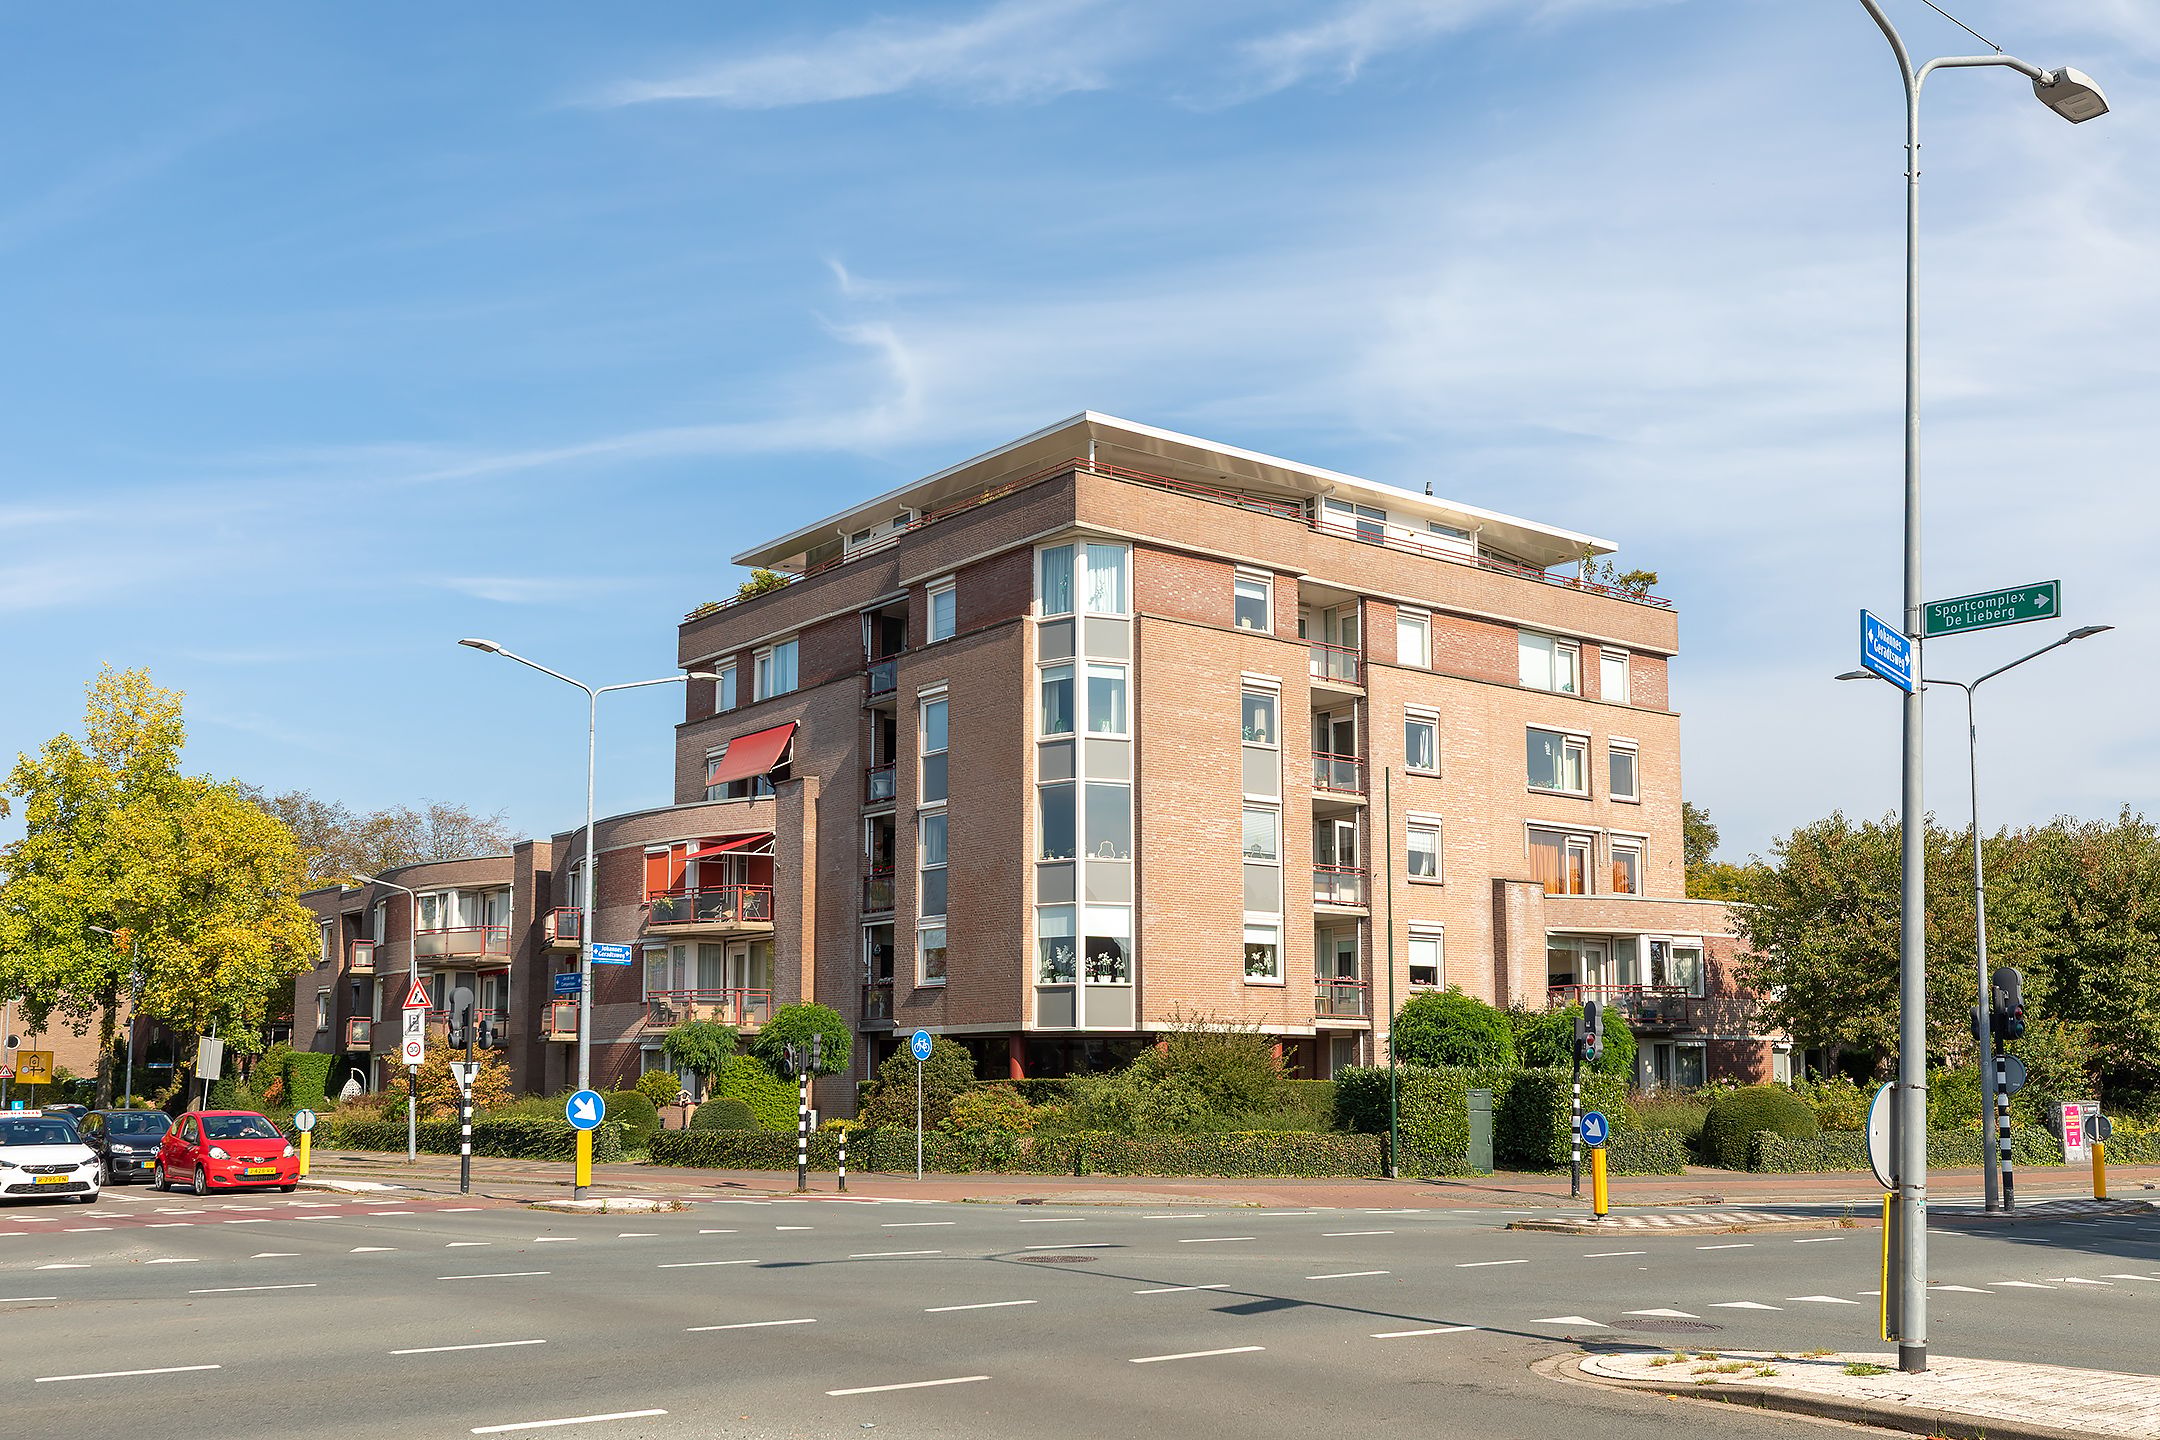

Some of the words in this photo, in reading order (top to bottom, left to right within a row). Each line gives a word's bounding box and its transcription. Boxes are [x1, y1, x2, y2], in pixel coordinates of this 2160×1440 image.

[1935, 592, 2026, 618] Sportcomplex
[1946, 615, 1962, 627] De
[1966, 607, 2015, 624] Lieberg
[1877, 624, 1902, 652] Johannes
[1873, 637, 1905, 673] Geradtsweg
